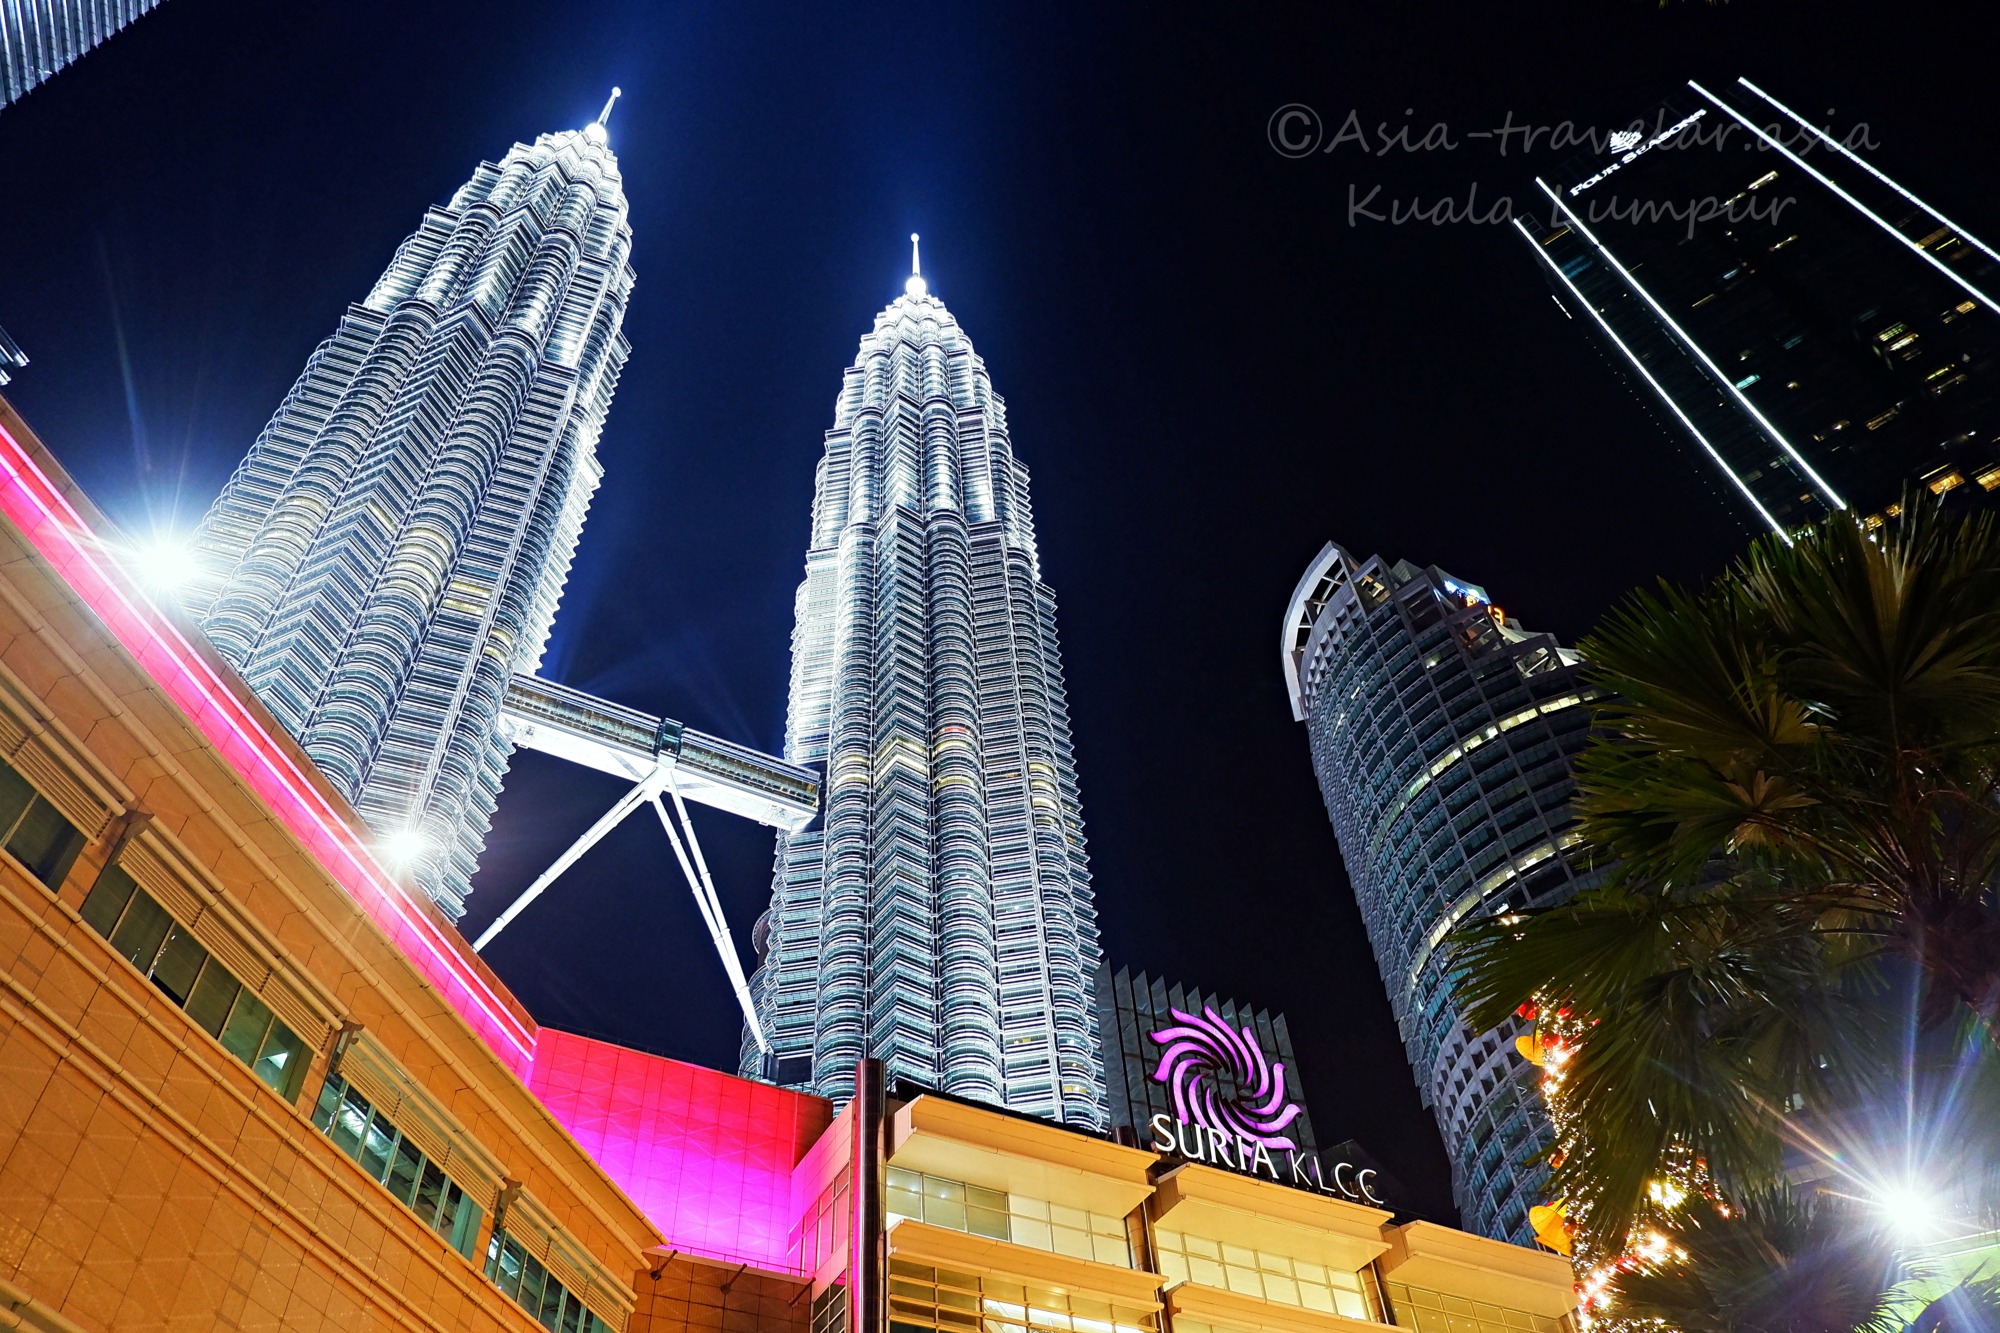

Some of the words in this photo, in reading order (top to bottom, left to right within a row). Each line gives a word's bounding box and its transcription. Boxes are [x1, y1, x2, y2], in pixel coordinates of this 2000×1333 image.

[1570, 163, 1621, 197] FOUR
[1151, 1113, 1280, 1180] SURIA
[1289, 1149, 1384, 1205] KLCC
